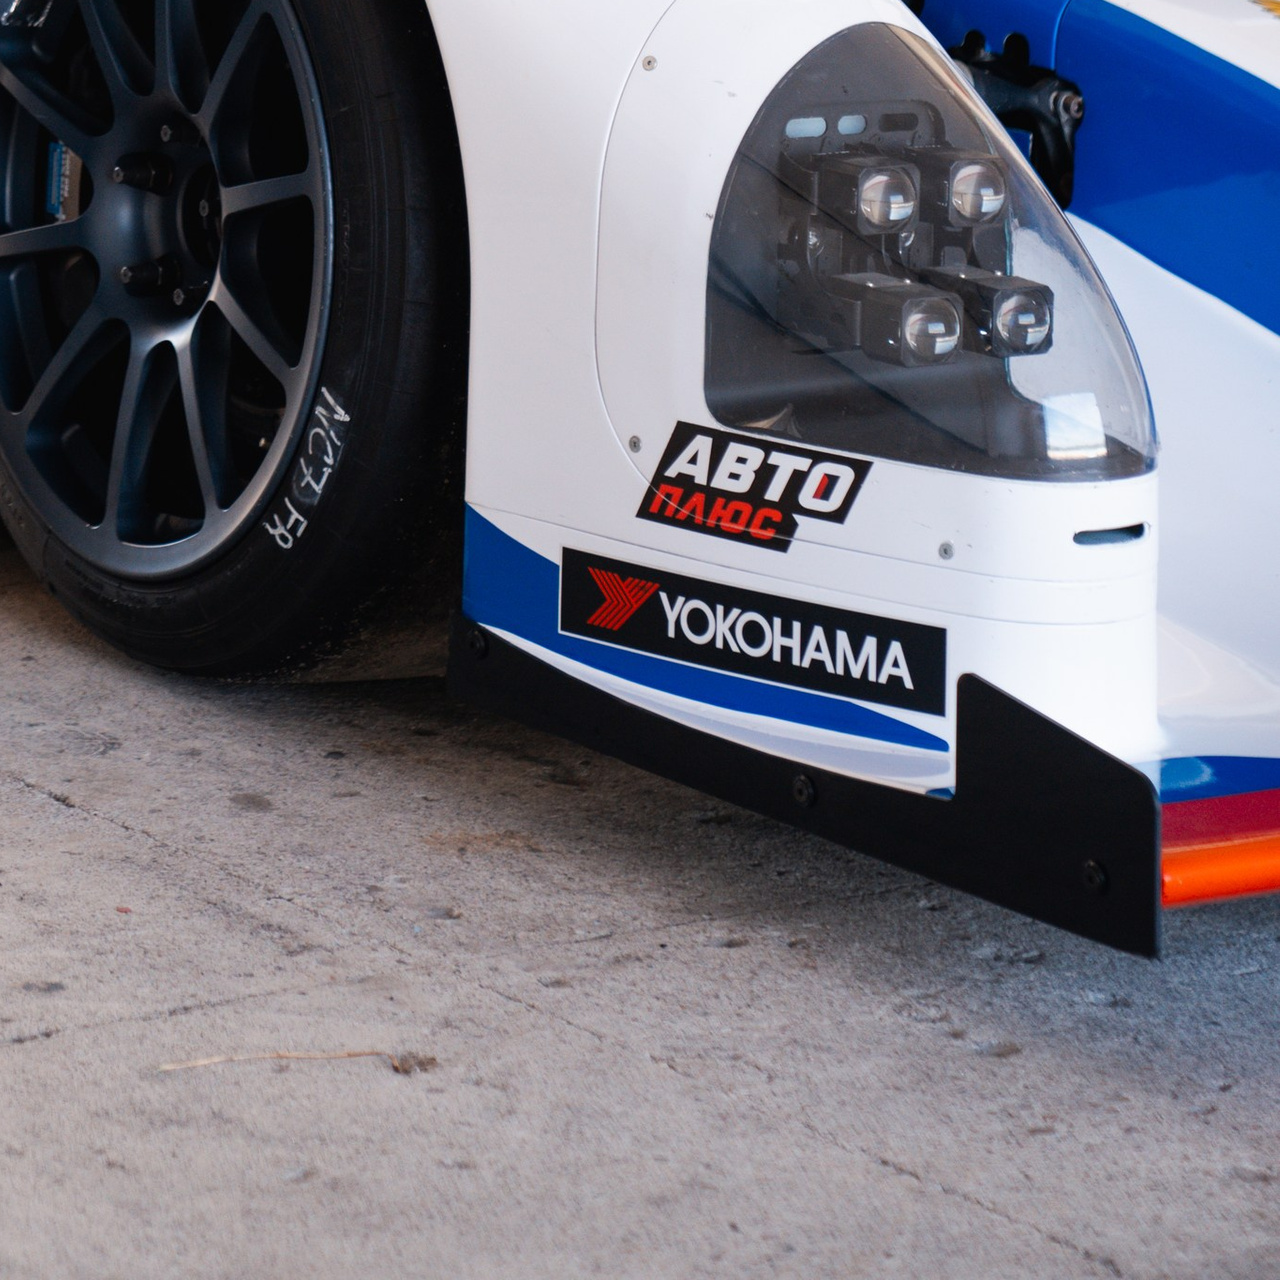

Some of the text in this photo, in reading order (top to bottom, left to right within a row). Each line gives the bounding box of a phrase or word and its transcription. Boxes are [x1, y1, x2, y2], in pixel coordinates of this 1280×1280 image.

[648, 483, 783, 541] ПЛЮС
[664, 433, 856, 514] АВТО
[658, 590, 915, 691] YOKOHAMA
